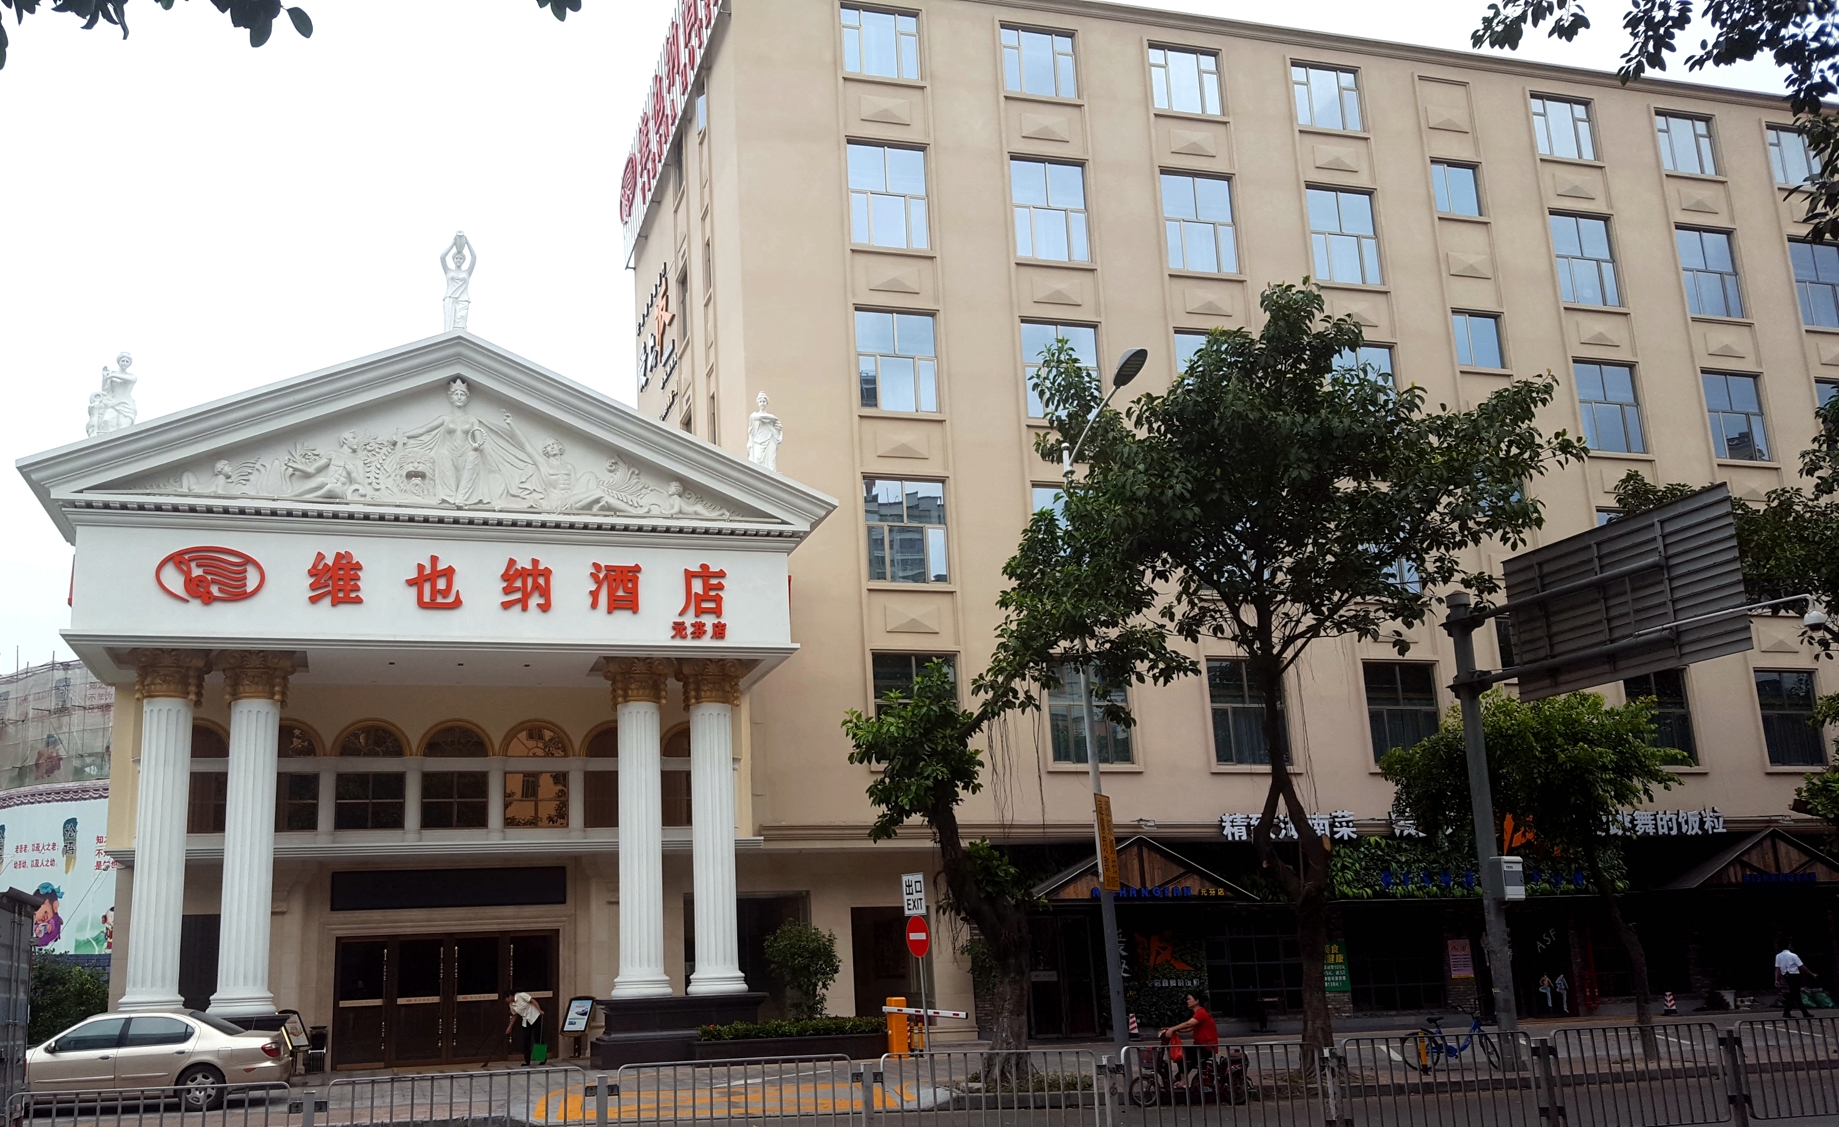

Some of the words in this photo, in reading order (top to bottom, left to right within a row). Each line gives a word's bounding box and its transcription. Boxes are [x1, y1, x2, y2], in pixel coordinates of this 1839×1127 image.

[307, 551, 727, 619] 维也纳酒店
[670, 621, 727, 640] 元芬店
[64, 823, 78, 856] 论语
[95, 835, 107, 845] 知
[95, 860, 119, 871] 是也
[905, 879, 922, 895] 出口
[1091, 886, 1191, 898] AHANGFAN
[1199, 888, 1225, 897] 元芬店
[907, 898, 924, 911] EXIT
[1535, 928, 1557, 953] ASF
[1324, 954, 1344, 963] 健康
